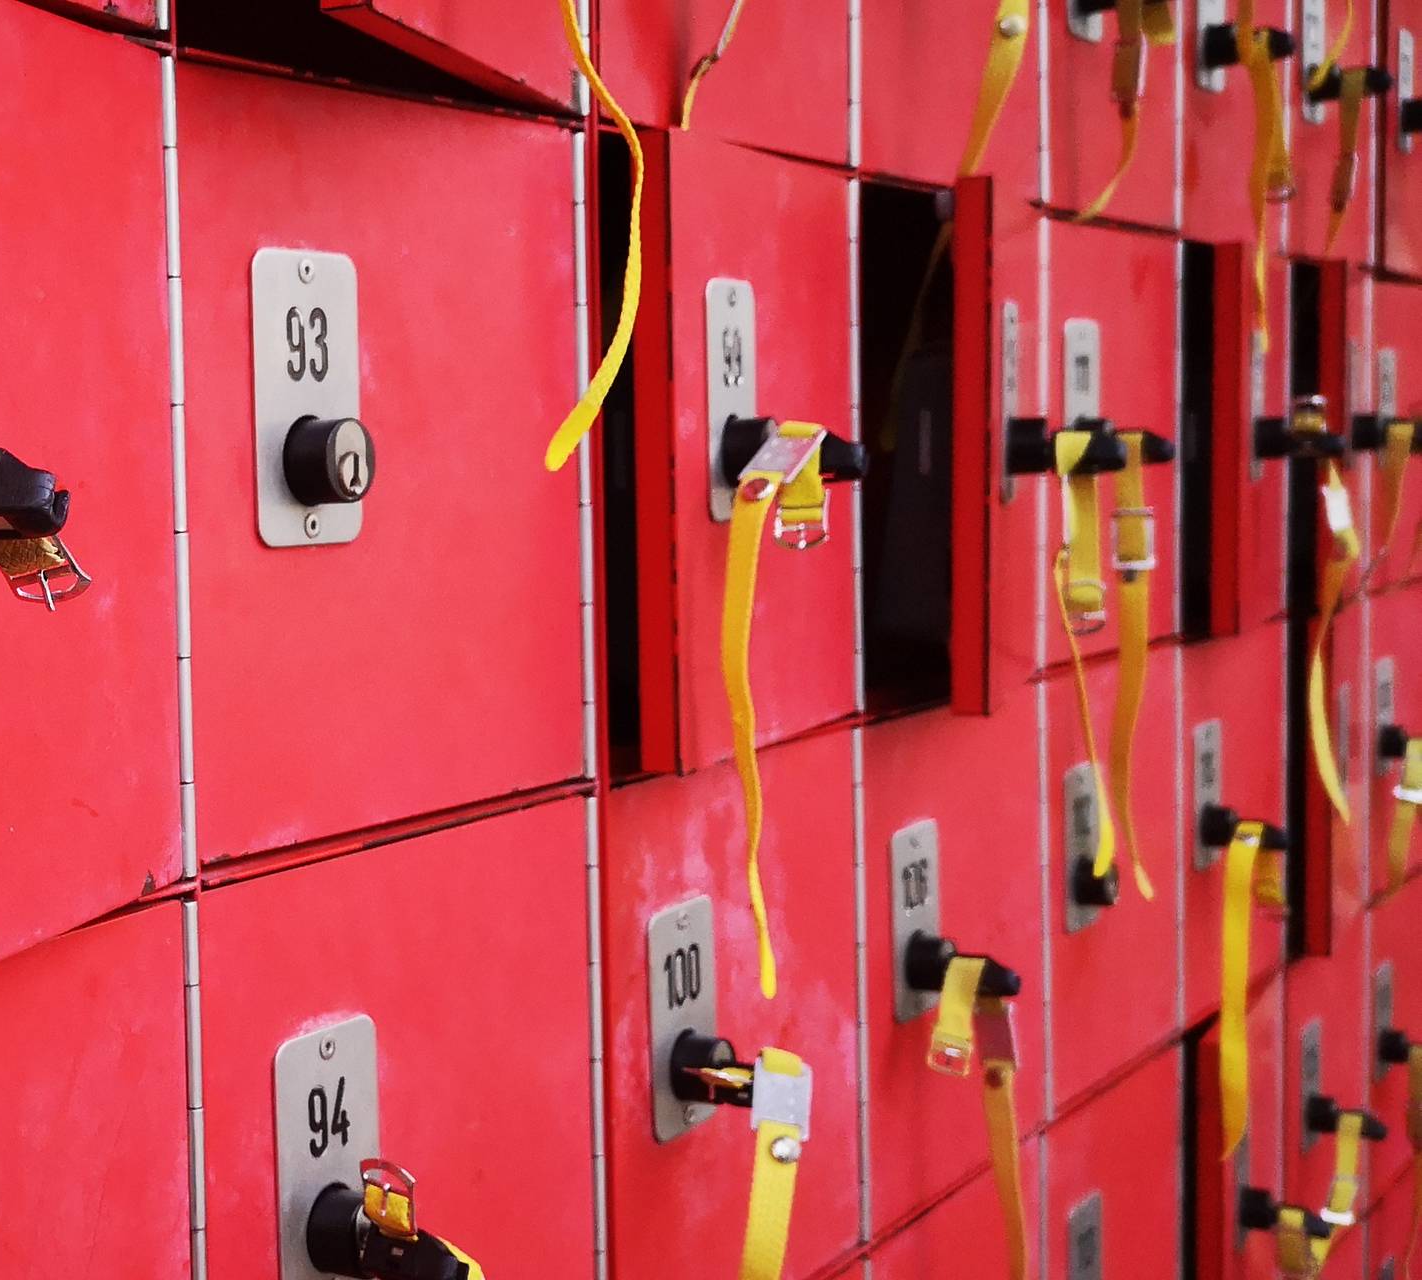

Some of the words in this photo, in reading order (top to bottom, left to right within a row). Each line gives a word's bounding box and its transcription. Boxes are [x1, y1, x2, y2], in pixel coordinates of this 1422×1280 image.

[286, 306, 329, 382] 93
[664, 943, 700, 1011] 100
[308, 1076, 350, 1159] 94
